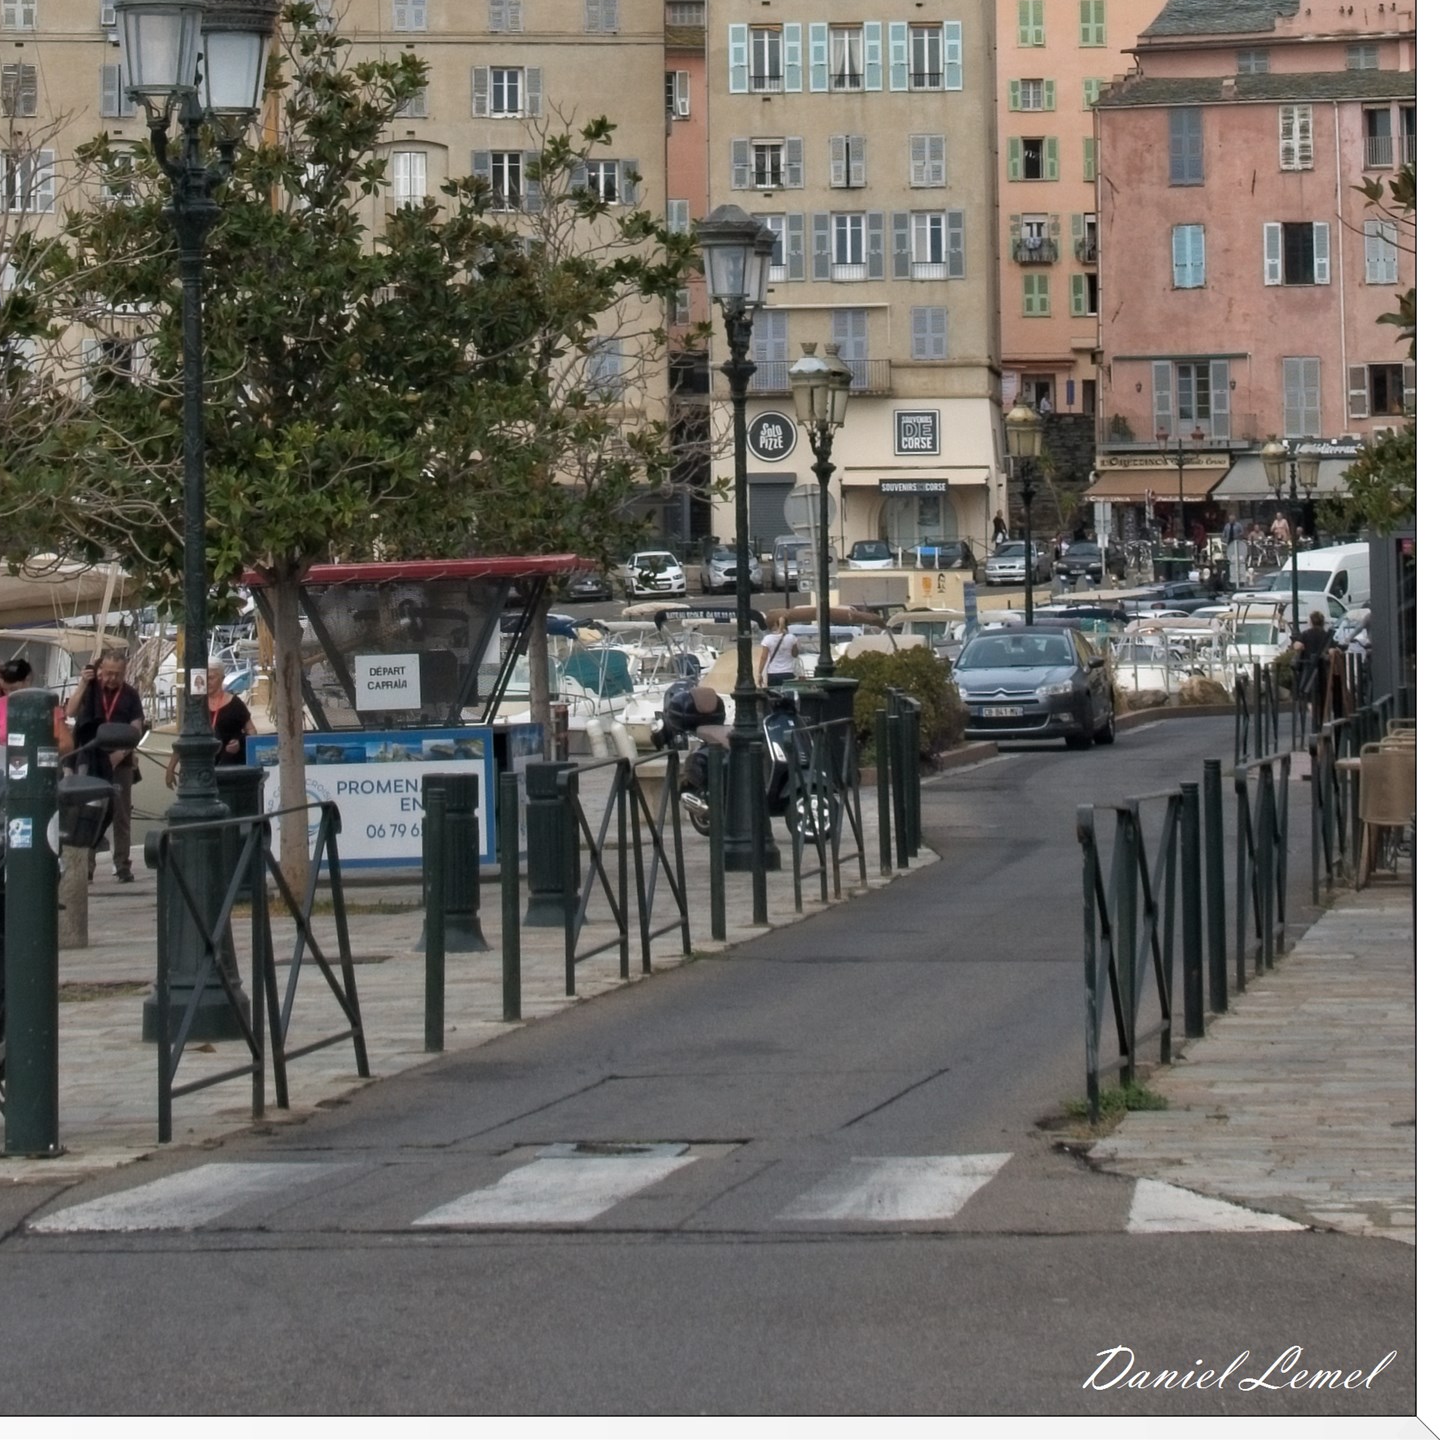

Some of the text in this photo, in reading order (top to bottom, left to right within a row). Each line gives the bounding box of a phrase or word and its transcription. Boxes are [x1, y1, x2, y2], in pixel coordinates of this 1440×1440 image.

[902, 422, 933, 438] DE
[902, 437, 933, 449] CORSE
[369, 665, 407, 676] DÉPART
[337, 779, 422, 795] PROMEN
[366, 823, 422, 839] 06 79 6
